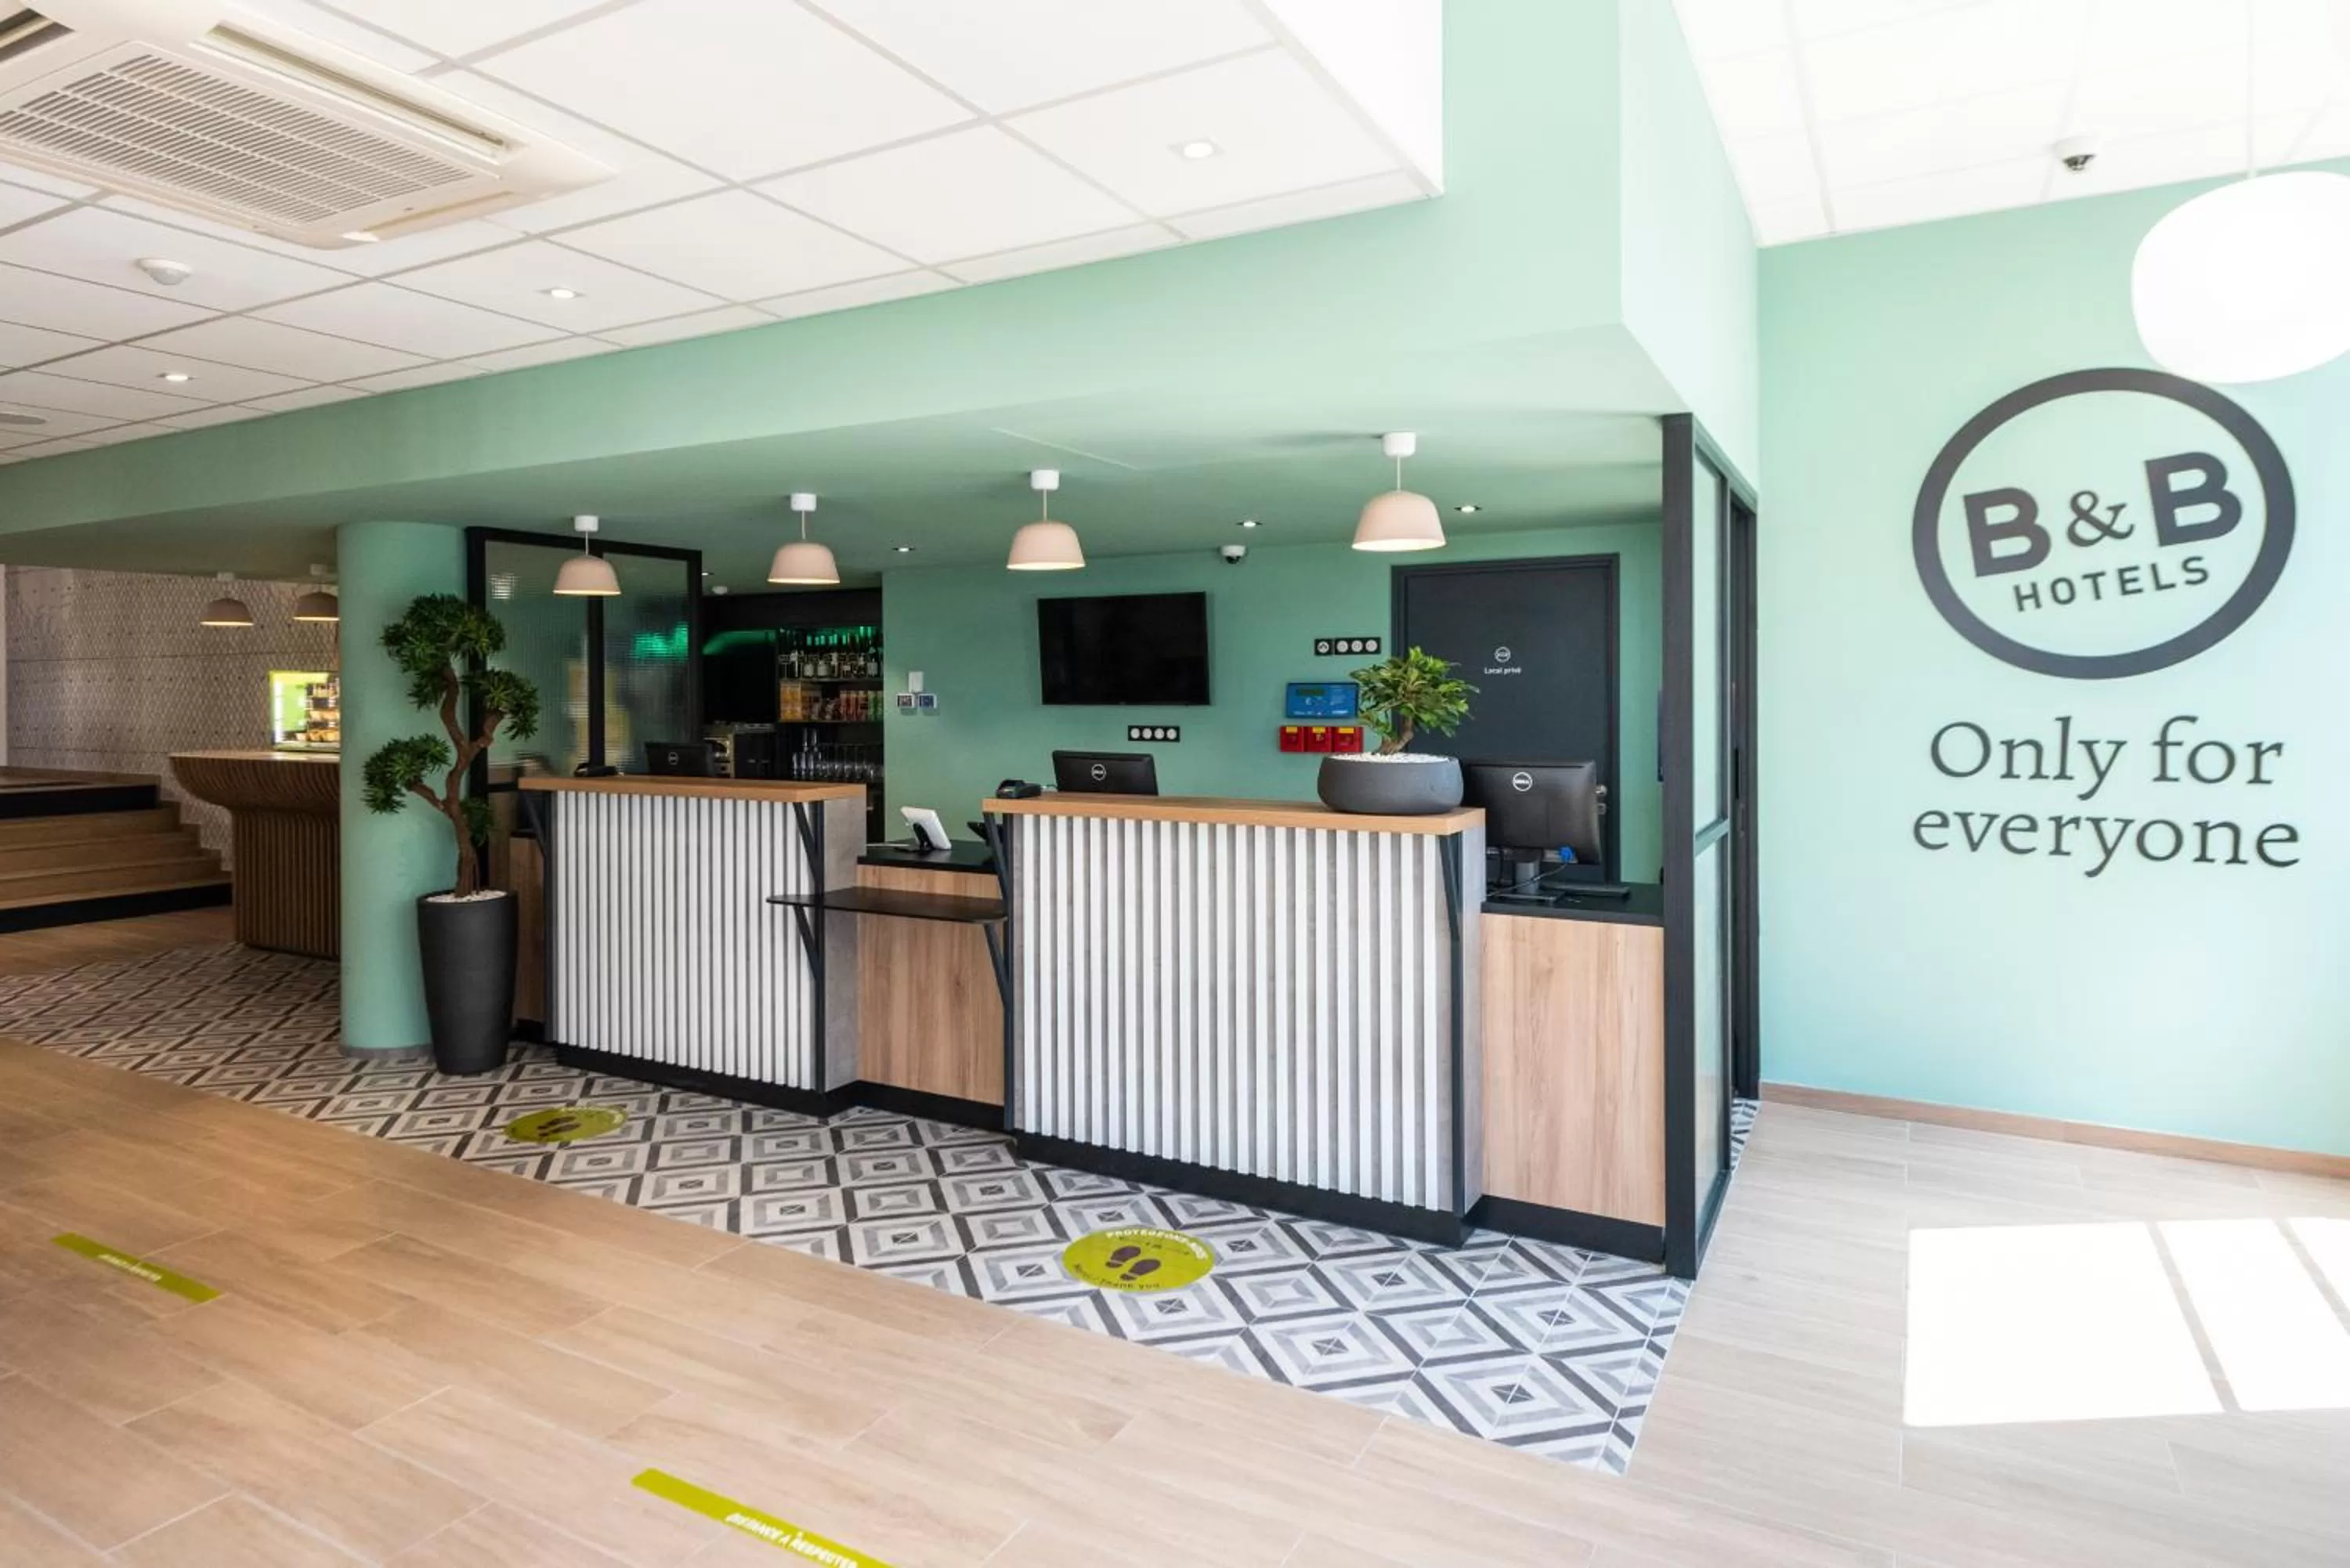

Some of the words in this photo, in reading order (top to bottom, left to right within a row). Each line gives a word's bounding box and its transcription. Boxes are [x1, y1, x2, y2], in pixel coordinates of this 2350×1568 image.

[1962, 450, 2243, 578] B&B
[2013, 555, 2211, 612] HOTELS
[1929, 715, 2128, 801] Only
[2152, 715, 2284, 786] for
[1912, 809, 2301, 879] everyone
